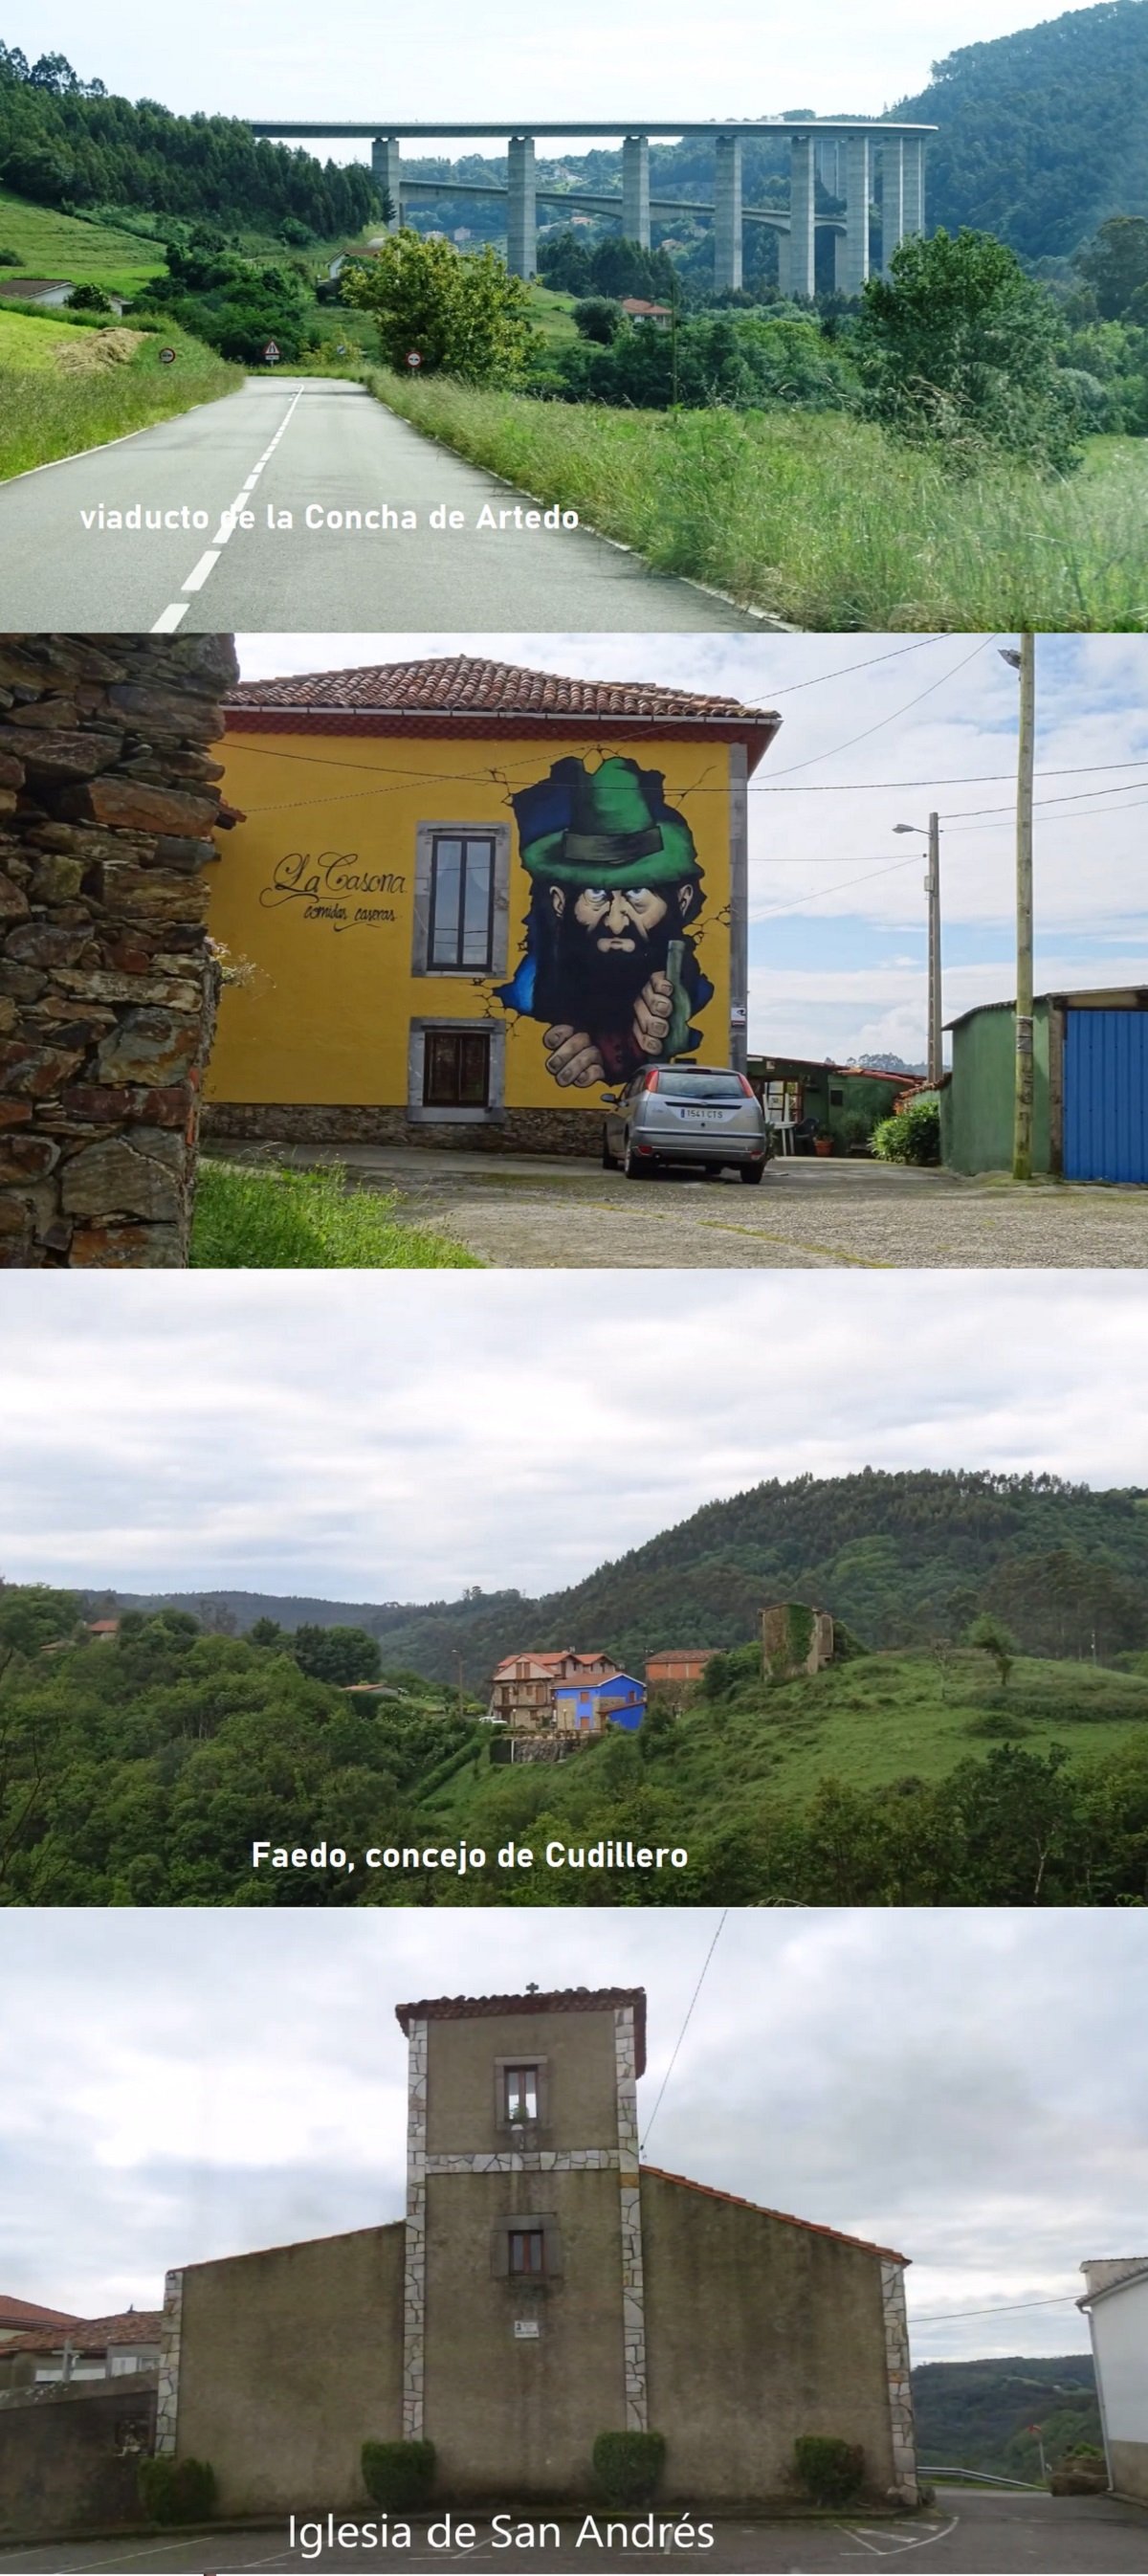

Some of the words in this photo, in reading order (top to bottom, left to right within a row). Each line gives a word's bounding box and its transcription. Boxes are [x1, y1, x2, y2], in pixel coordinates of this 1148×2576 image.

[271, 852, 320, 895] La
[317, 851, 407, 894] Casona
[303, 903, 348, 920] comidas
[354, 907, 397, 922] caseras
[686, 1109, 706, 1119] 1541
[706, 1110, 723, 1119] CTS
